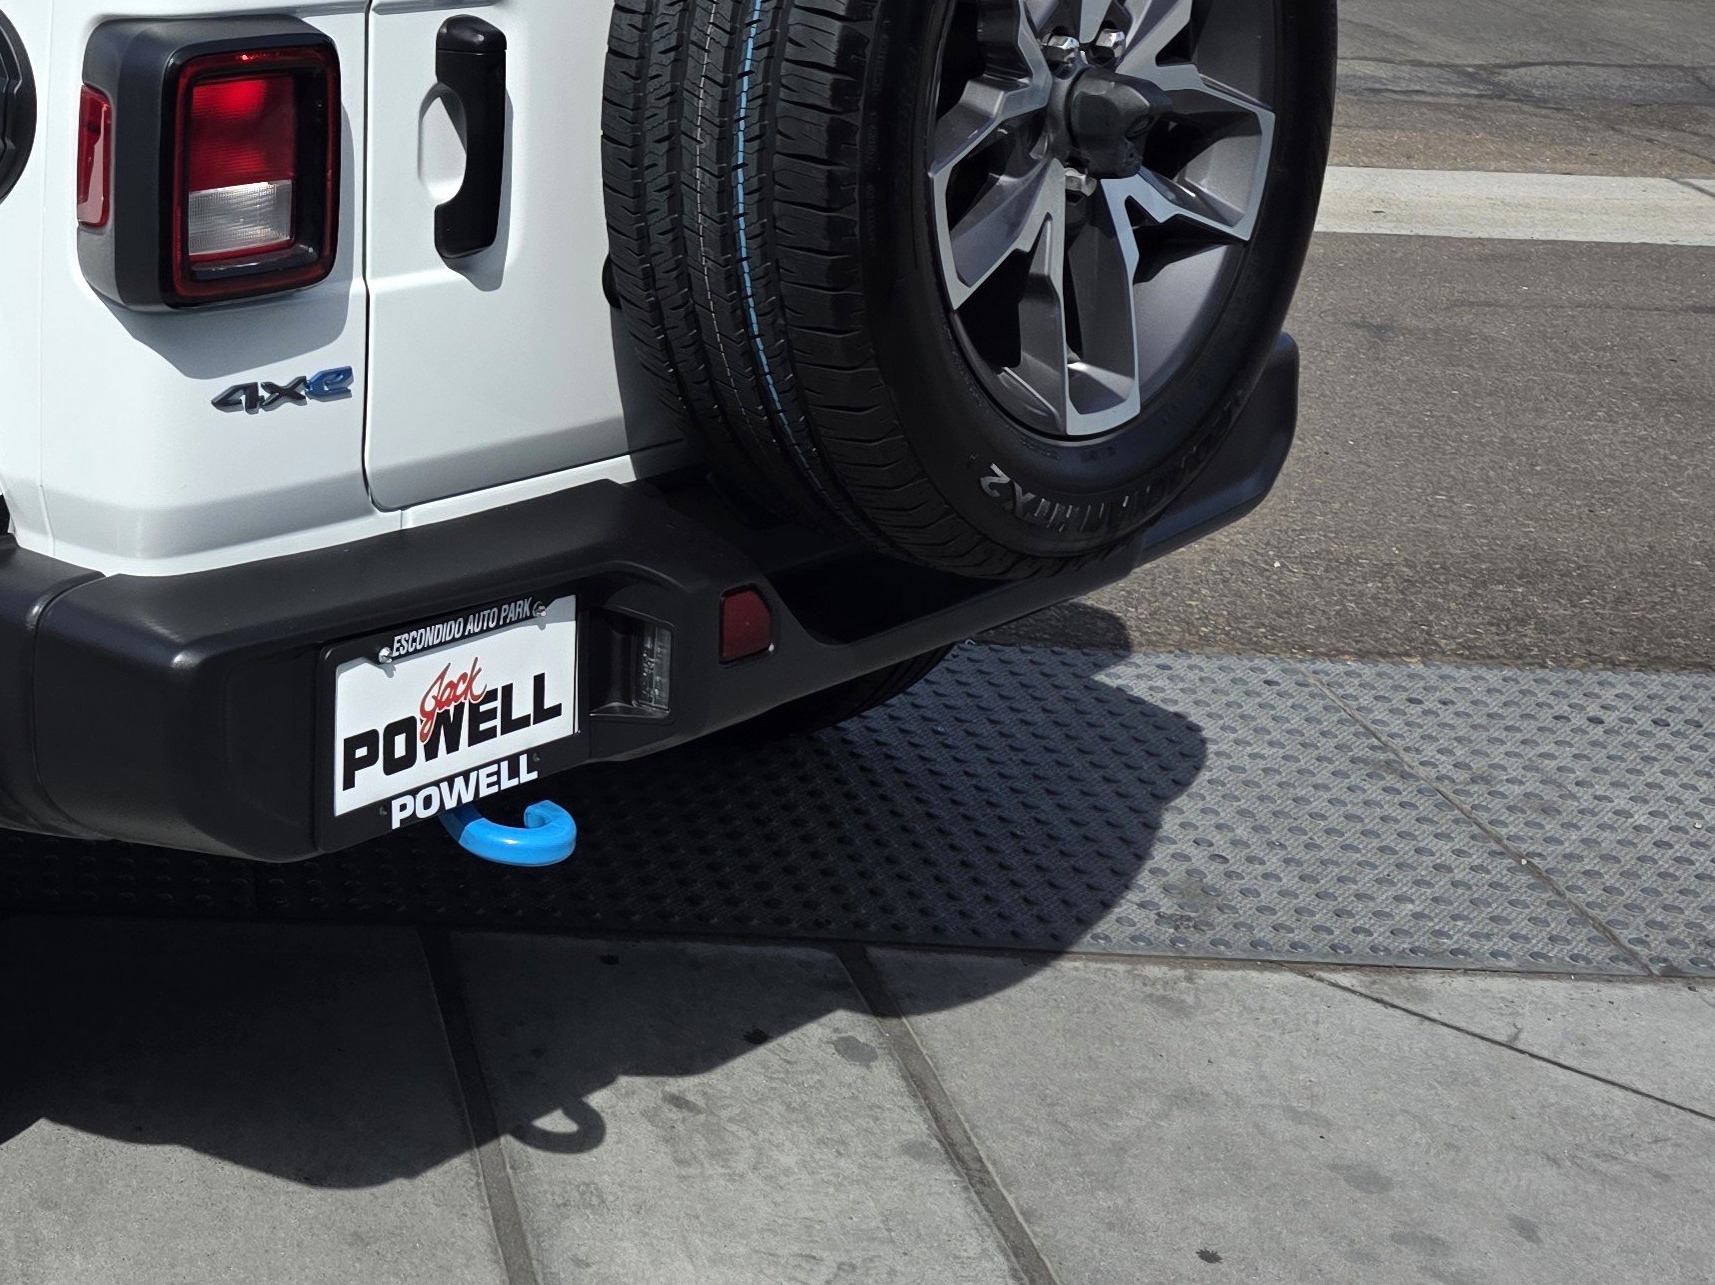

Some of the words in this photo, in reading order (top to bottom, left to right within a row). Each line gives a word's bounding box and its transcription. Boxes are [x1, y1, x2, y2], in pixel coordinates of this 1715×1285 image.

[392, 617, 464, 657] ESCONDIDO
[465, 608, 499, 634] AUTO
[499, 597, 533, 626] PARK
[343, 672, 562, 791] POWELL
[419, 657, 487, 744] Jack
[391, 754, 538, 829] POWELL
